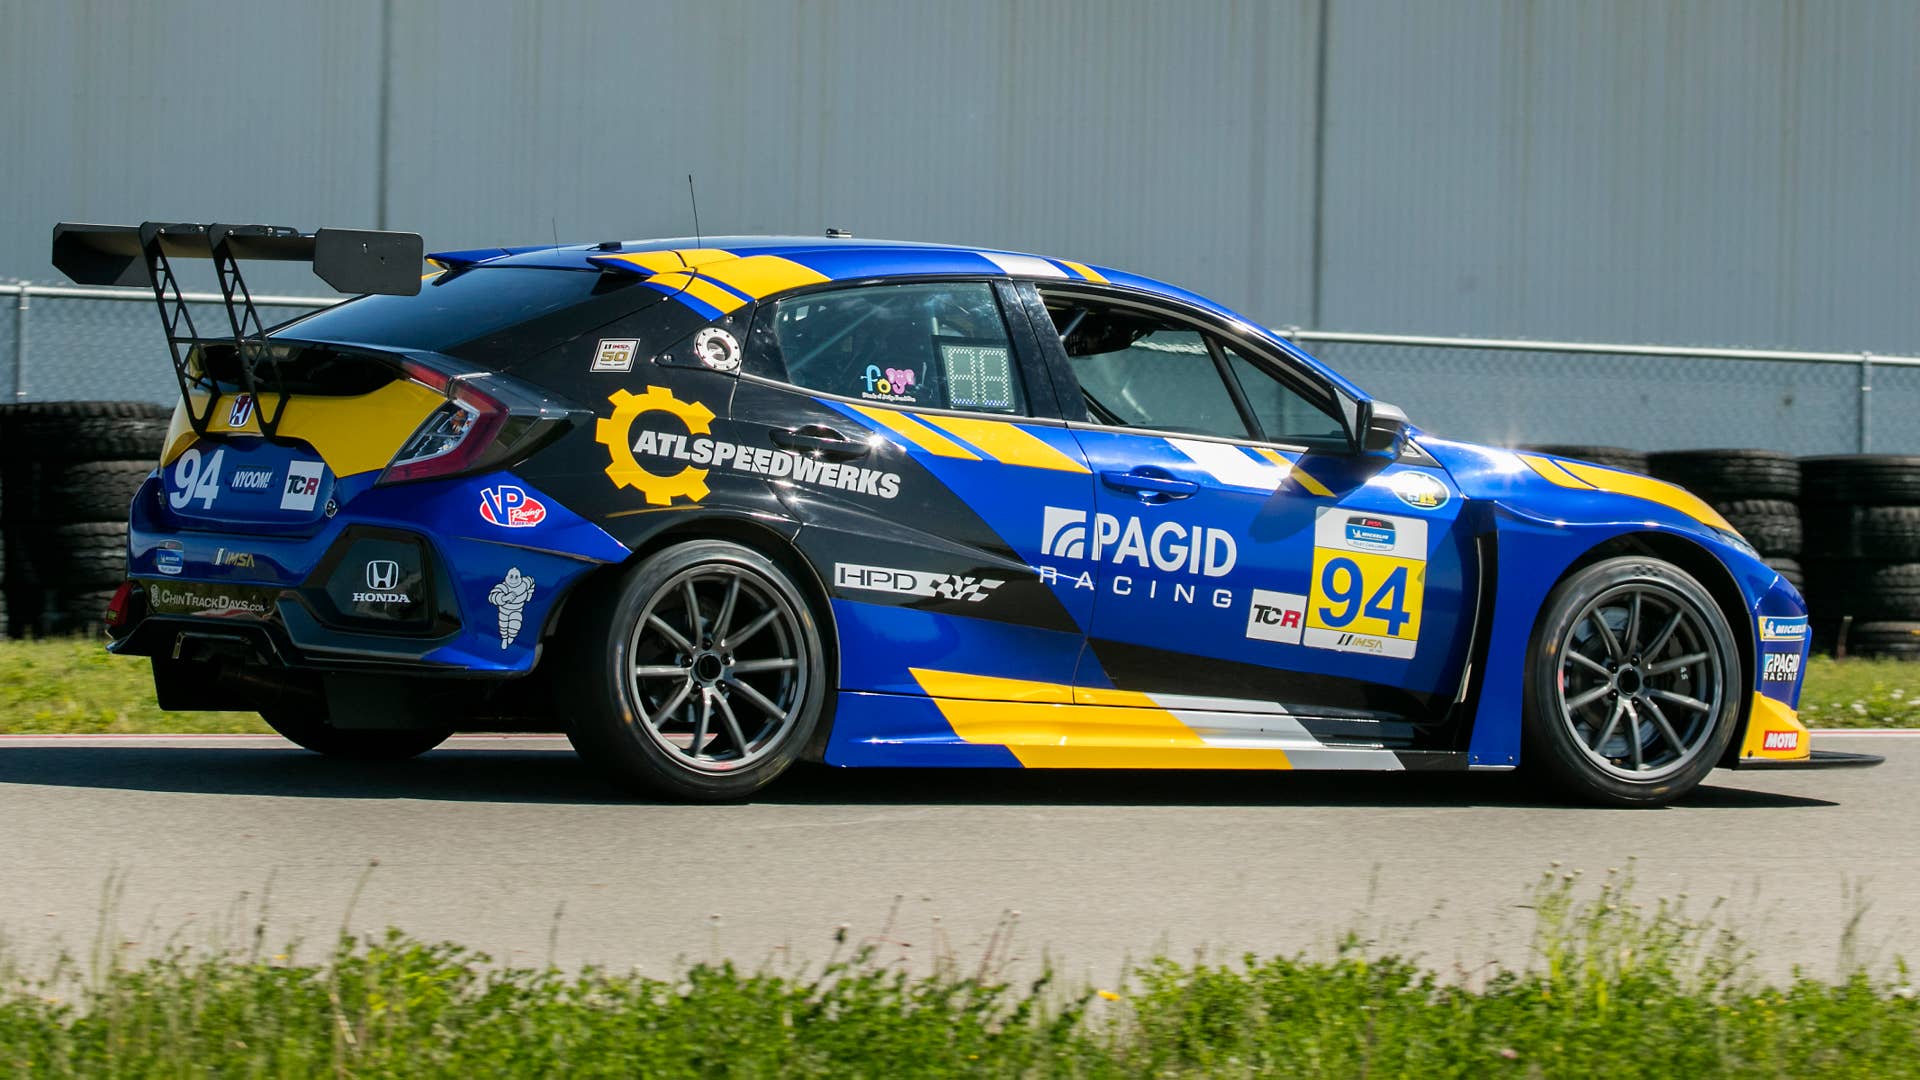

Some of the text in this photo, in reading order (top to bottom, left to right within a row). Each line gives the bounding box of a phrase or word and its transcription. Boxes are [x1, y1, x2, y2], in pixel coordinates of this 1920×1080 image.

[600, 351, 629, 362] 50
[632, 430, 901, 499] ATLSPEEDWERKS
[169, 448, 225, 510] 94
[231, 471, 273, 489] NYOOM!
[286, 475, 319, 496] TCR
[480, 485, 526, 526] VP
[1091, 512, 1238, 578] PAGID
[224, 551, 256, 568] IMSA
[839, 567, 918, 591] HPD
[1039, 565, 1233, 608] RACING
[352, 592, 411, 603] HONDA
[1317, 556, 1412, 636] 94
[1252, 603, 1302, 629] TCR
[1773, 652, 1801, 673] PAGID
